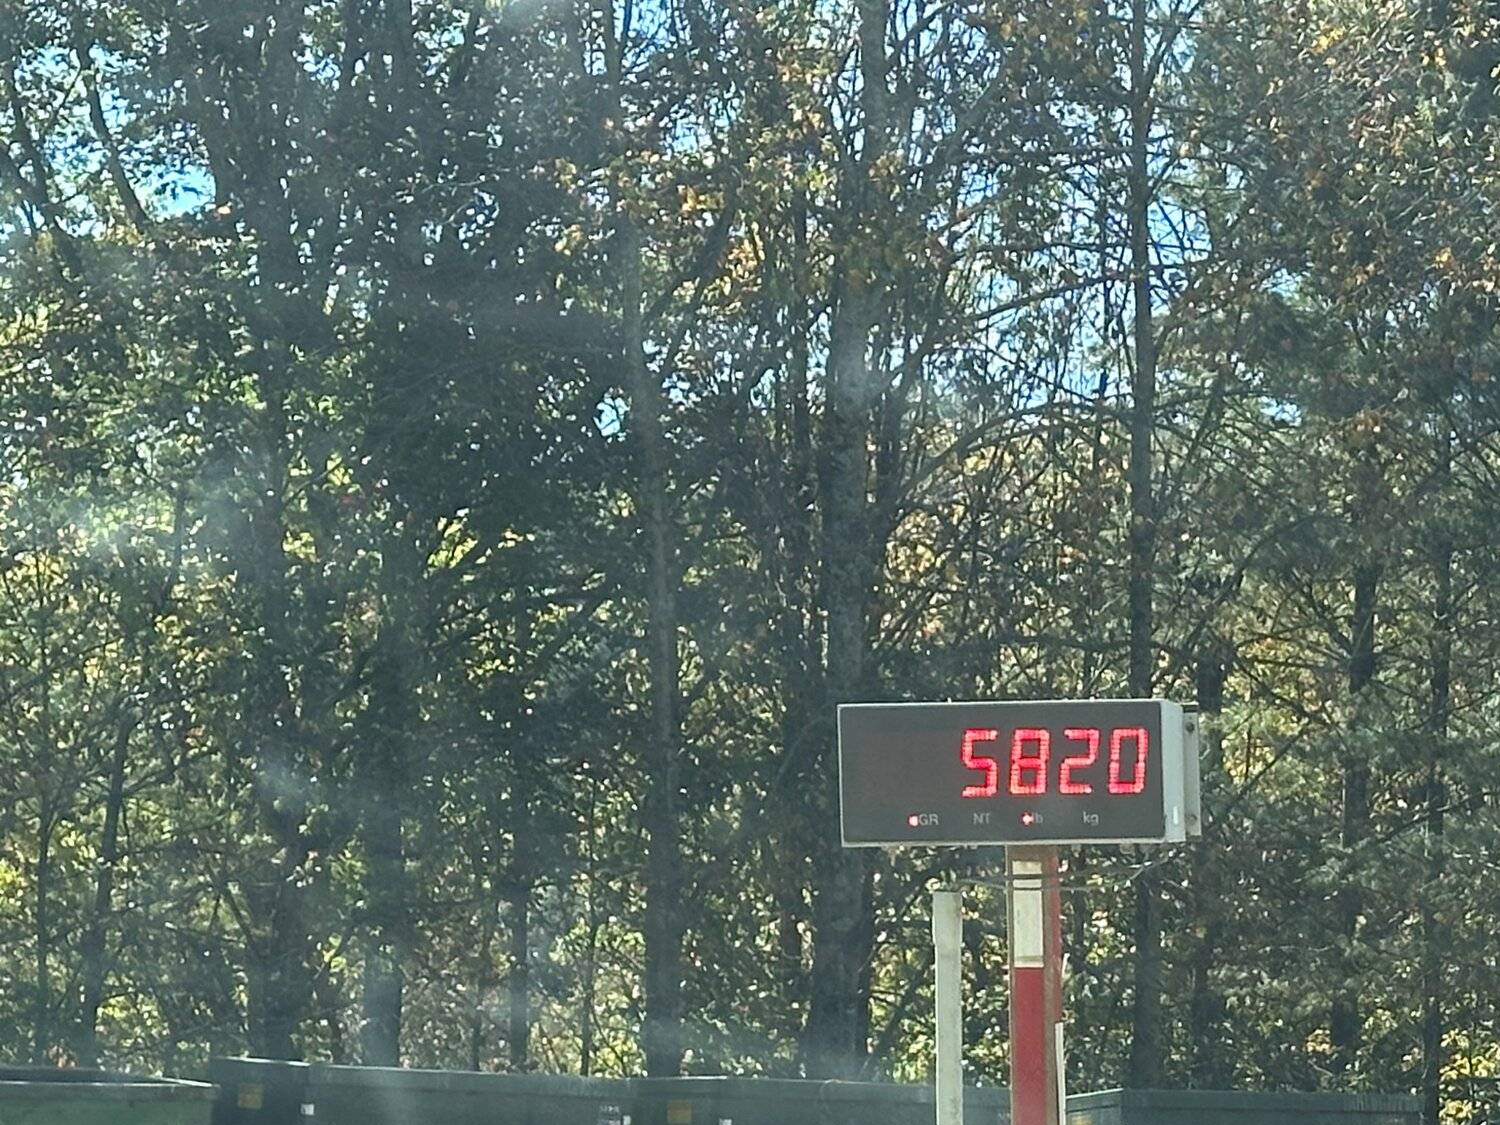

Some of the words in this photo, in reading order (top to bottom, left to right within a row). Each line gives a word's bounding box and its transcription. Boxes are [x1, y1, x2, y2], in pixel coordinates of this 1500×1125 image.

[960, 728, 1148, 797] 5820
[918, 814, 939, 825] GR
[973, 813, 990, 824] NT
[1083, 811, 1099, 826] kg
